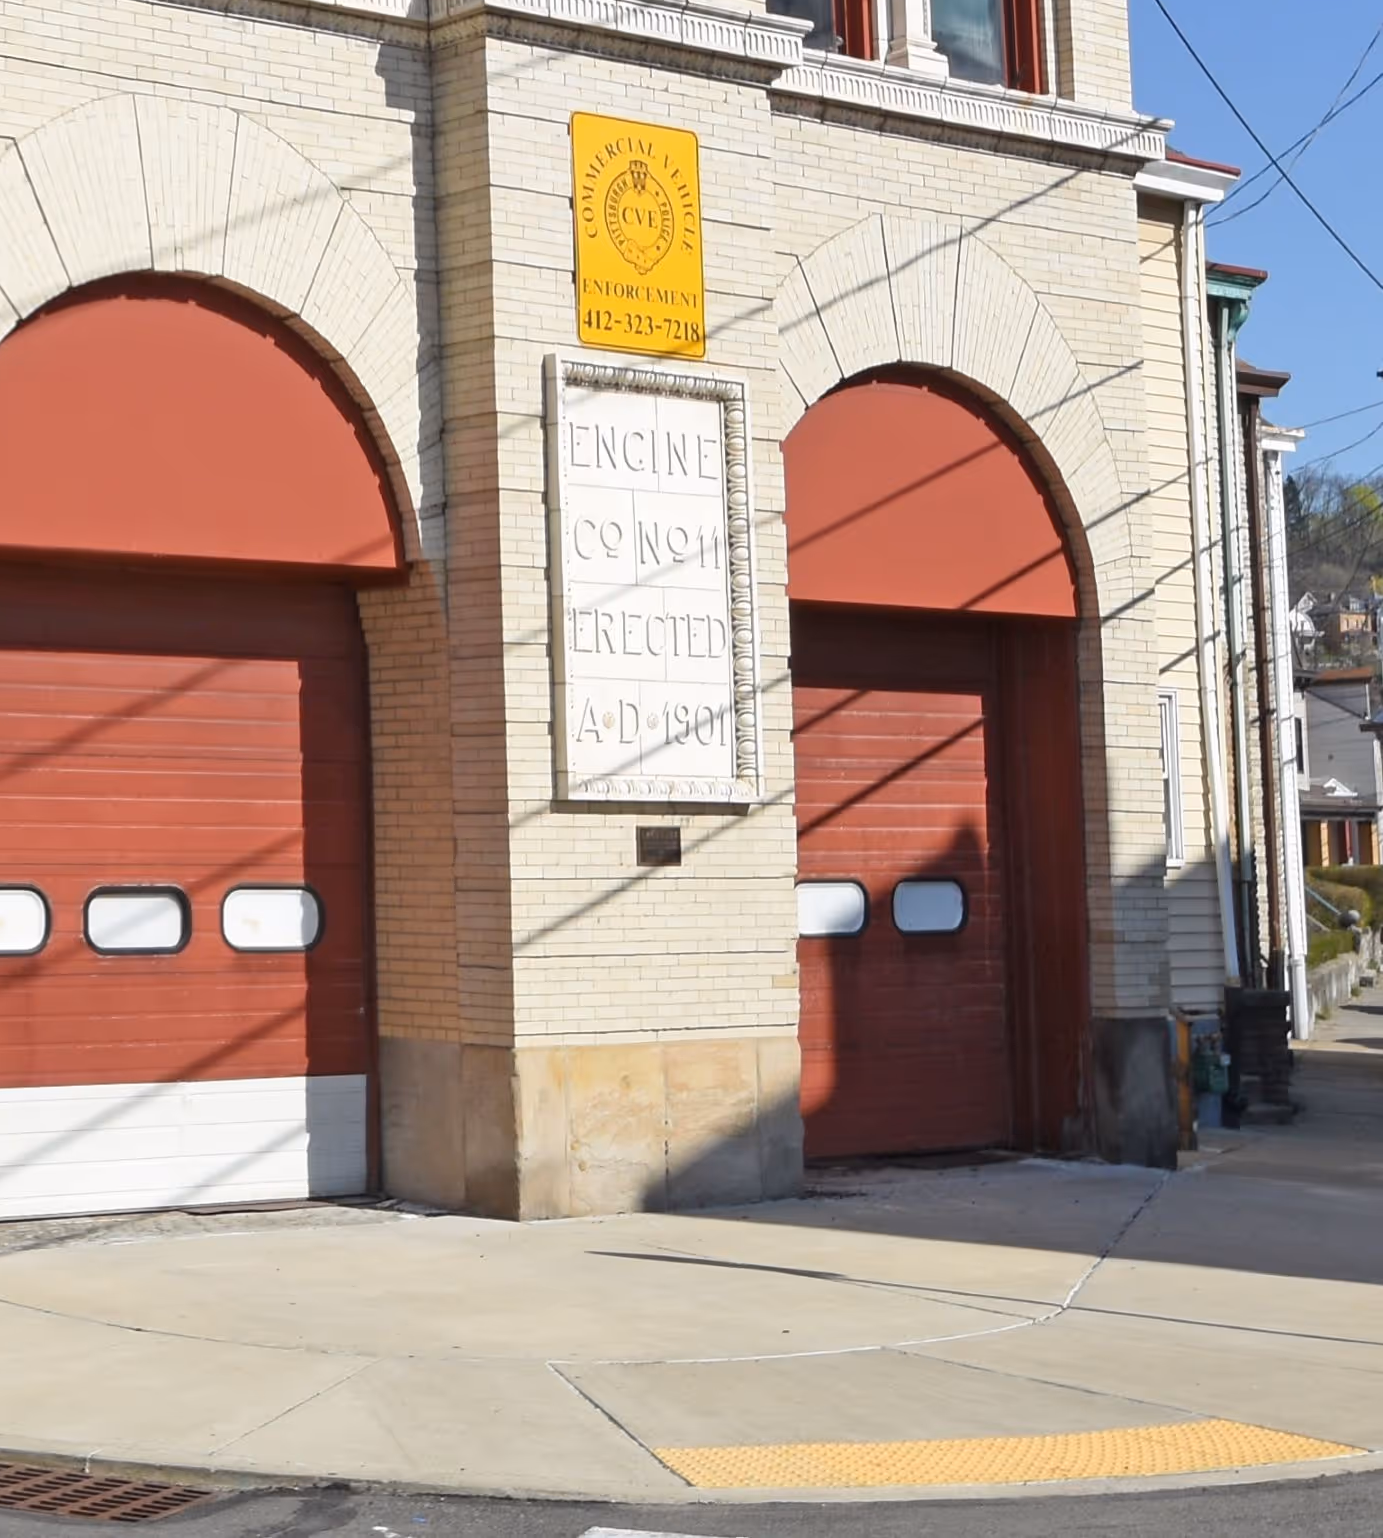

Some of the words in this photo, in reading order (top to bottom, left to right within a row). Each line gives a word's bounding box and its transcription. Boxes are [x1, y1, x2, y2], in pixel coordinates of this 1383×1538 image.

[582, 137, 656, 239] COMMERCIAL
[663, 154, 696, 256] VEHICLE
[622, 206, 658, 229] CVE
[660, 202, 671, 244] POLICE
[582, 278, 700, 309] ENFORCEMENT
[583, 308, 700, 343] 412-323-7218
[569, 422, 719, 480] ENGINE
[572, 608, 726, 658] ERECTED
